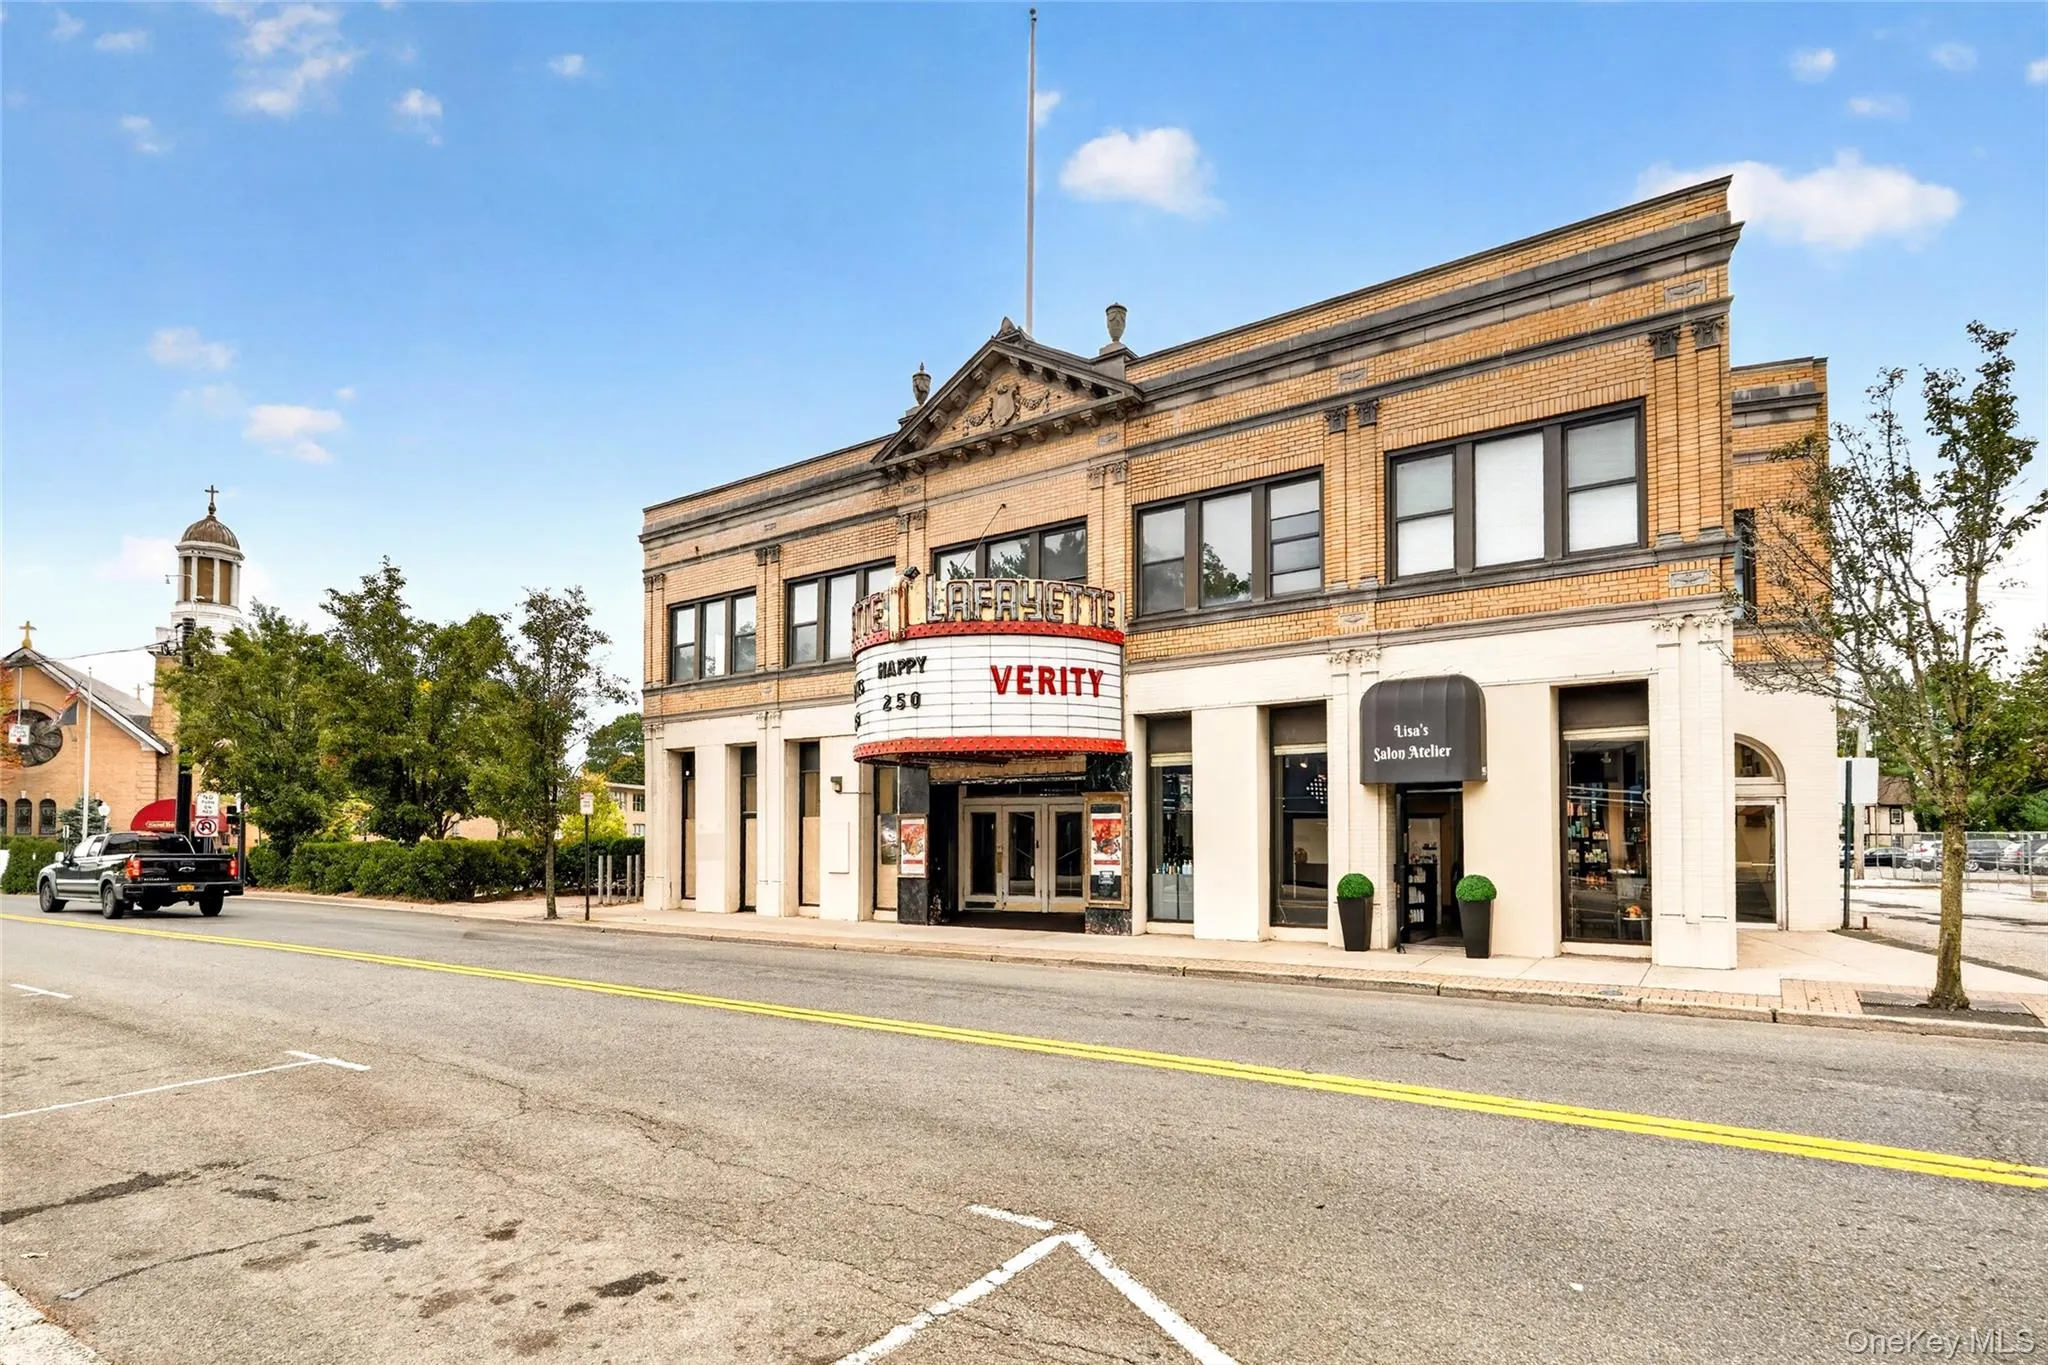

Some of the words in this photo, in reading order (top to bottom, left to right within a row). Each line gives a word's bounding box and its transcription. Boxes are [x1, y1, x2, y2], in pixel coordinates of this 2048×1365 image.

[926, 573, 1116, 629] LAFAYETTE
[878, 656, 928, 680] HAPPY
[990, 665, 1104, 698] VERITY
[883, 691, 921, 712] 250
[1394, 723, 1429, 738] Lisa's
[1373, 746, 1406, 762] Salon
[1408, 743, 1452, 759] Atelier
